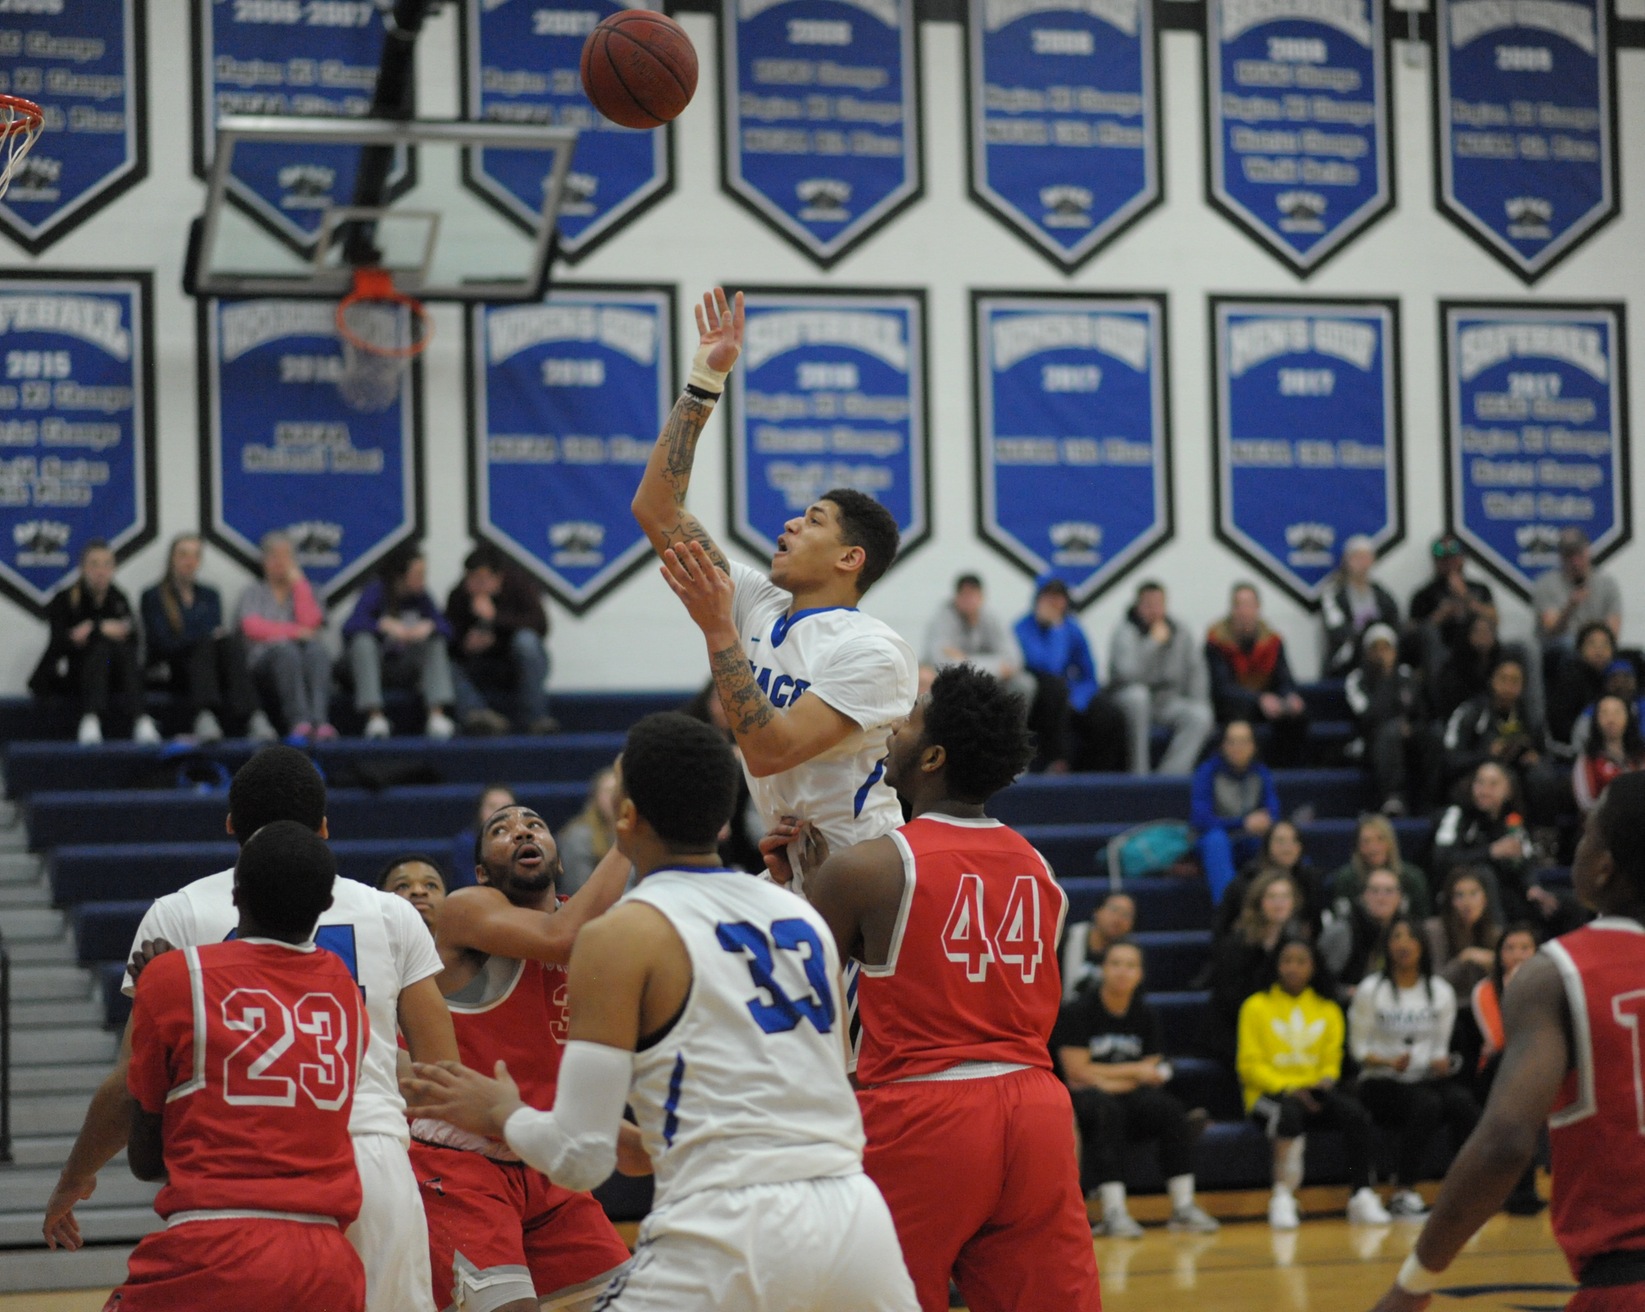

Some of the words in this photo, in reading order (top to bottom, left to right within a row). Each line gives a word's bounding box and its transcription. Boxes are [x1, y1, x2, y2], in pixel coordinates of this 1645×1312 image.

[6, 350, 72, 380] 2015
[715, 918, 836, 1034] 33
[941, 874, 1043, 983] 44
[221, 988, 350, 1111] 23
